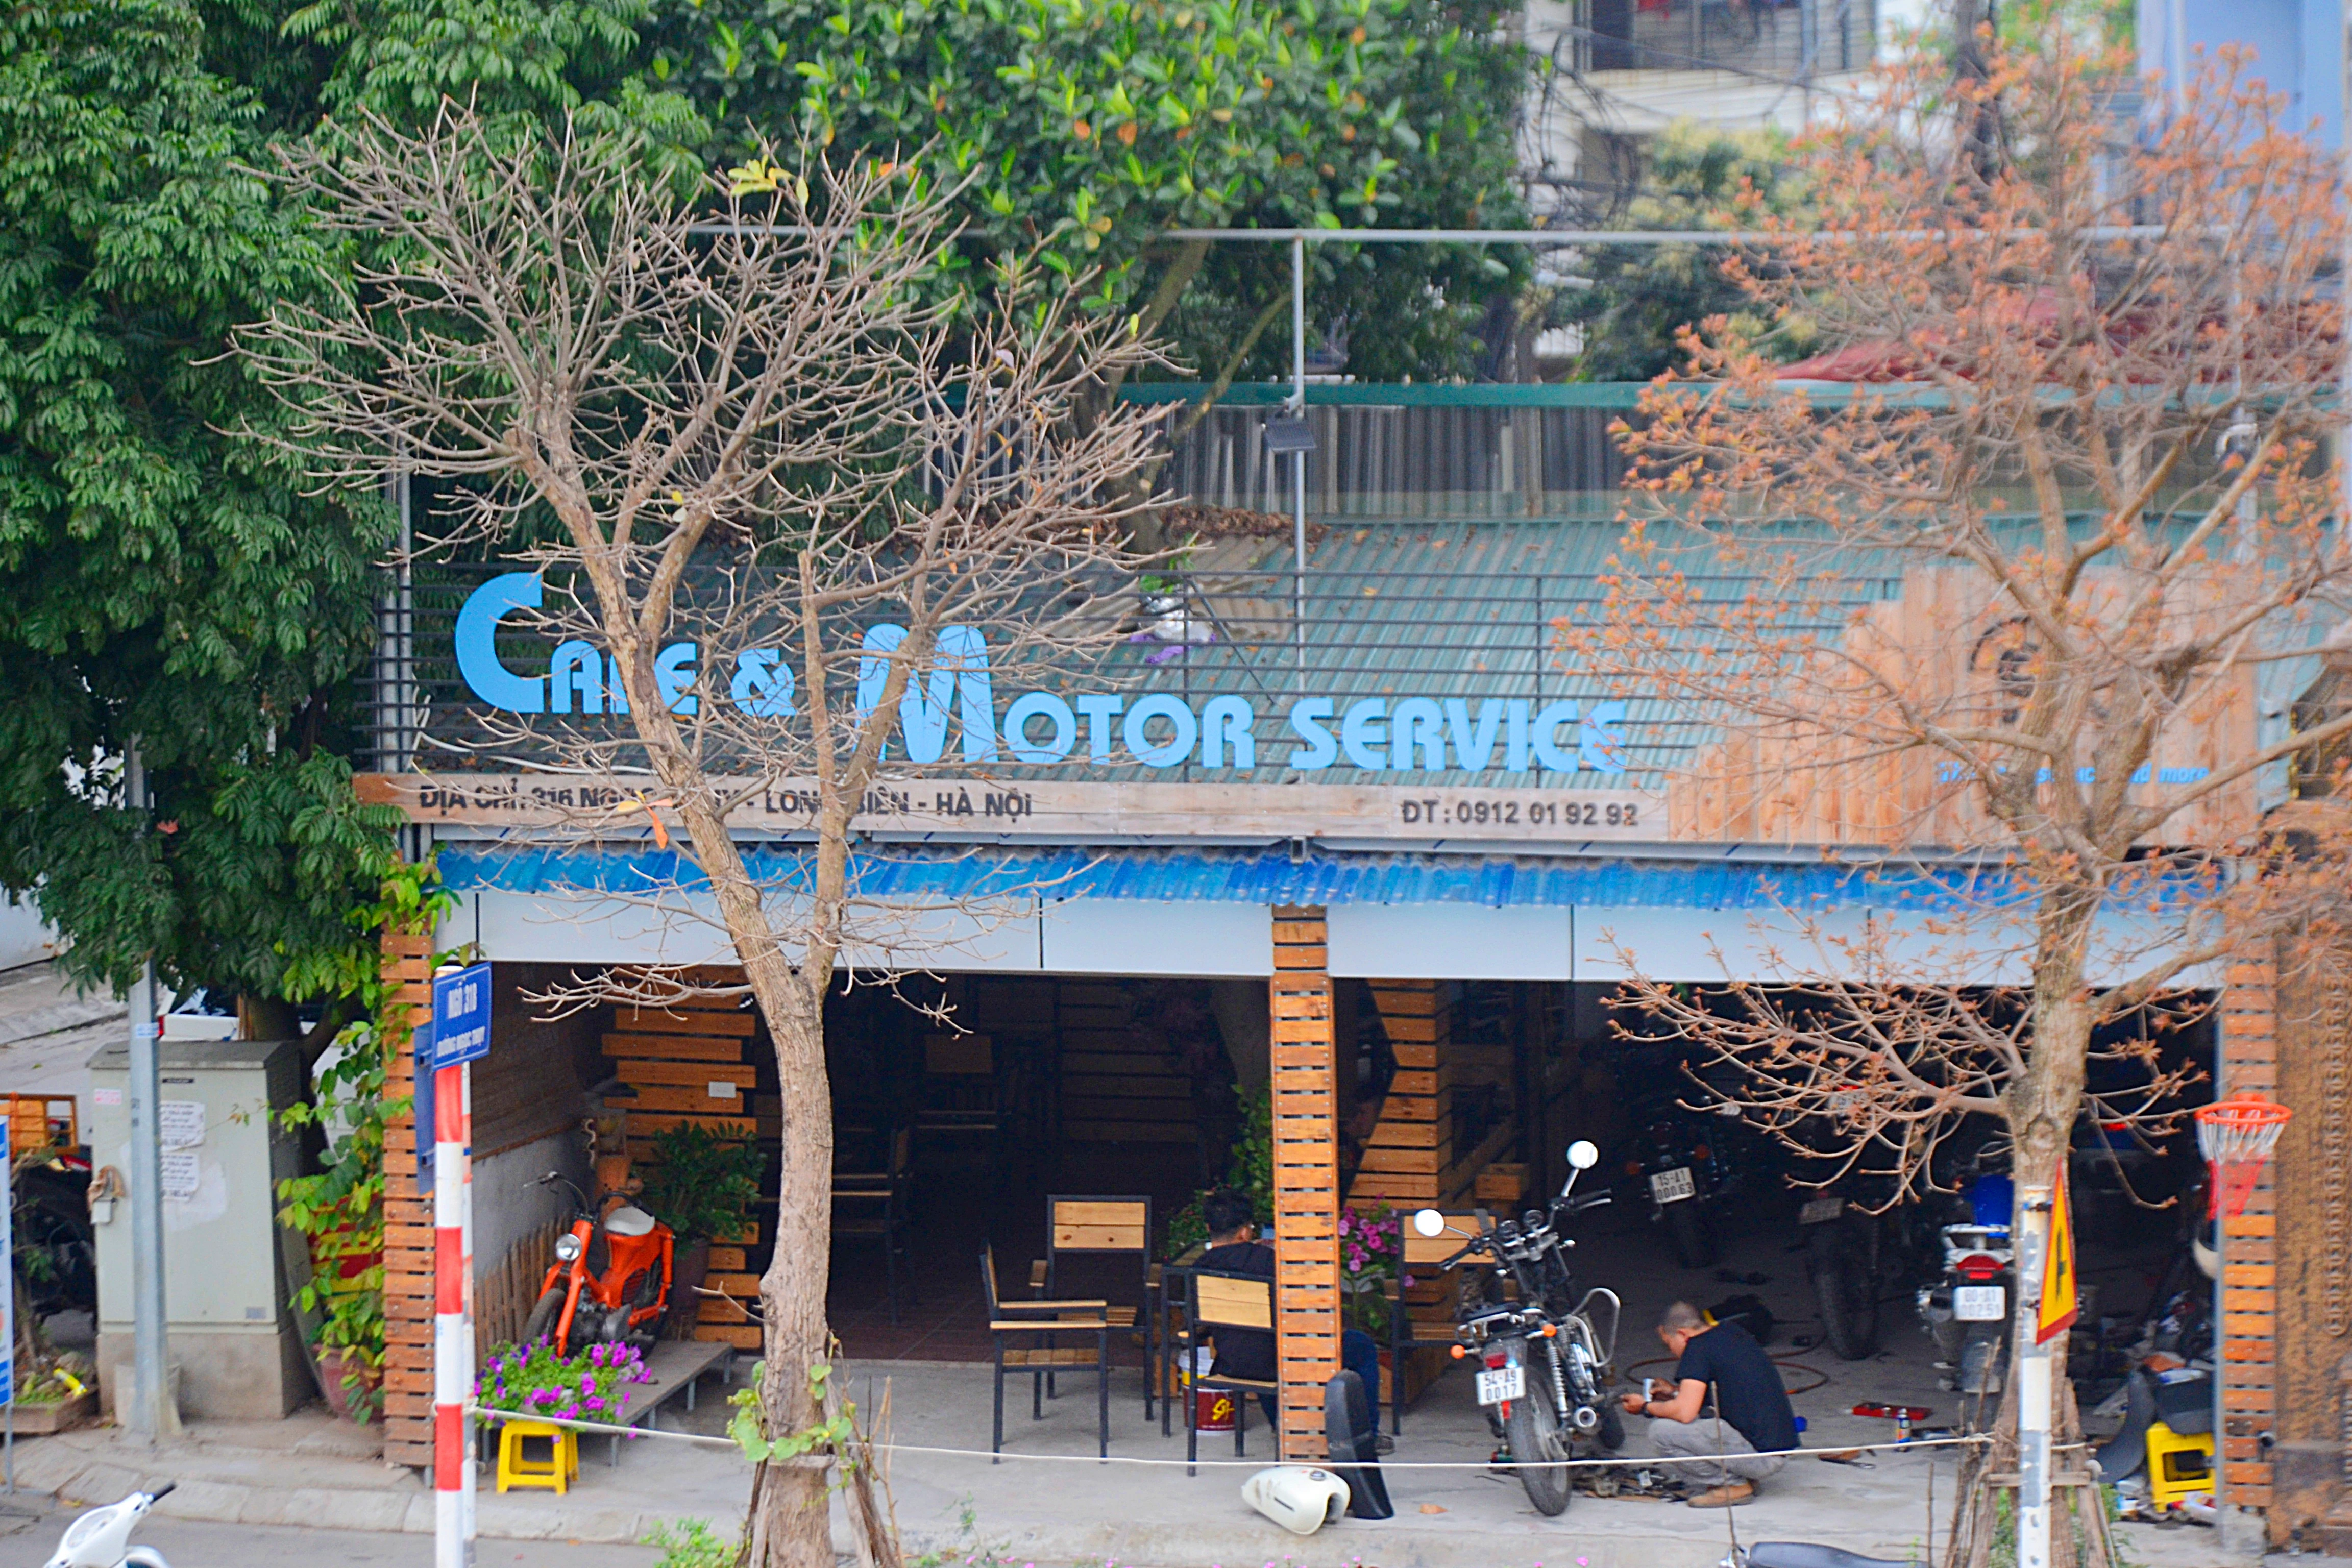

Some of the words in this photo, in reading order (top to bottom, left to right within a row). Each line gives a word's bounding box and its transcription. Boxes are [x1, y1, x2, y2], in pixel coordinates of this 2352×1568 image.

[731, 648, 797, 716] &
[853, 623, 1255, 768] MOTOR
[1291, 697, 1626, 773] SERVICE
[937, 786, 974, 816] HÀ
[1457, 800, 1519, 824] 0912
[1530, 802, 1556, 824] 01
[1566, 802, 1597, 825] 92
[1486, 1383, 1517, 1401] 0017
